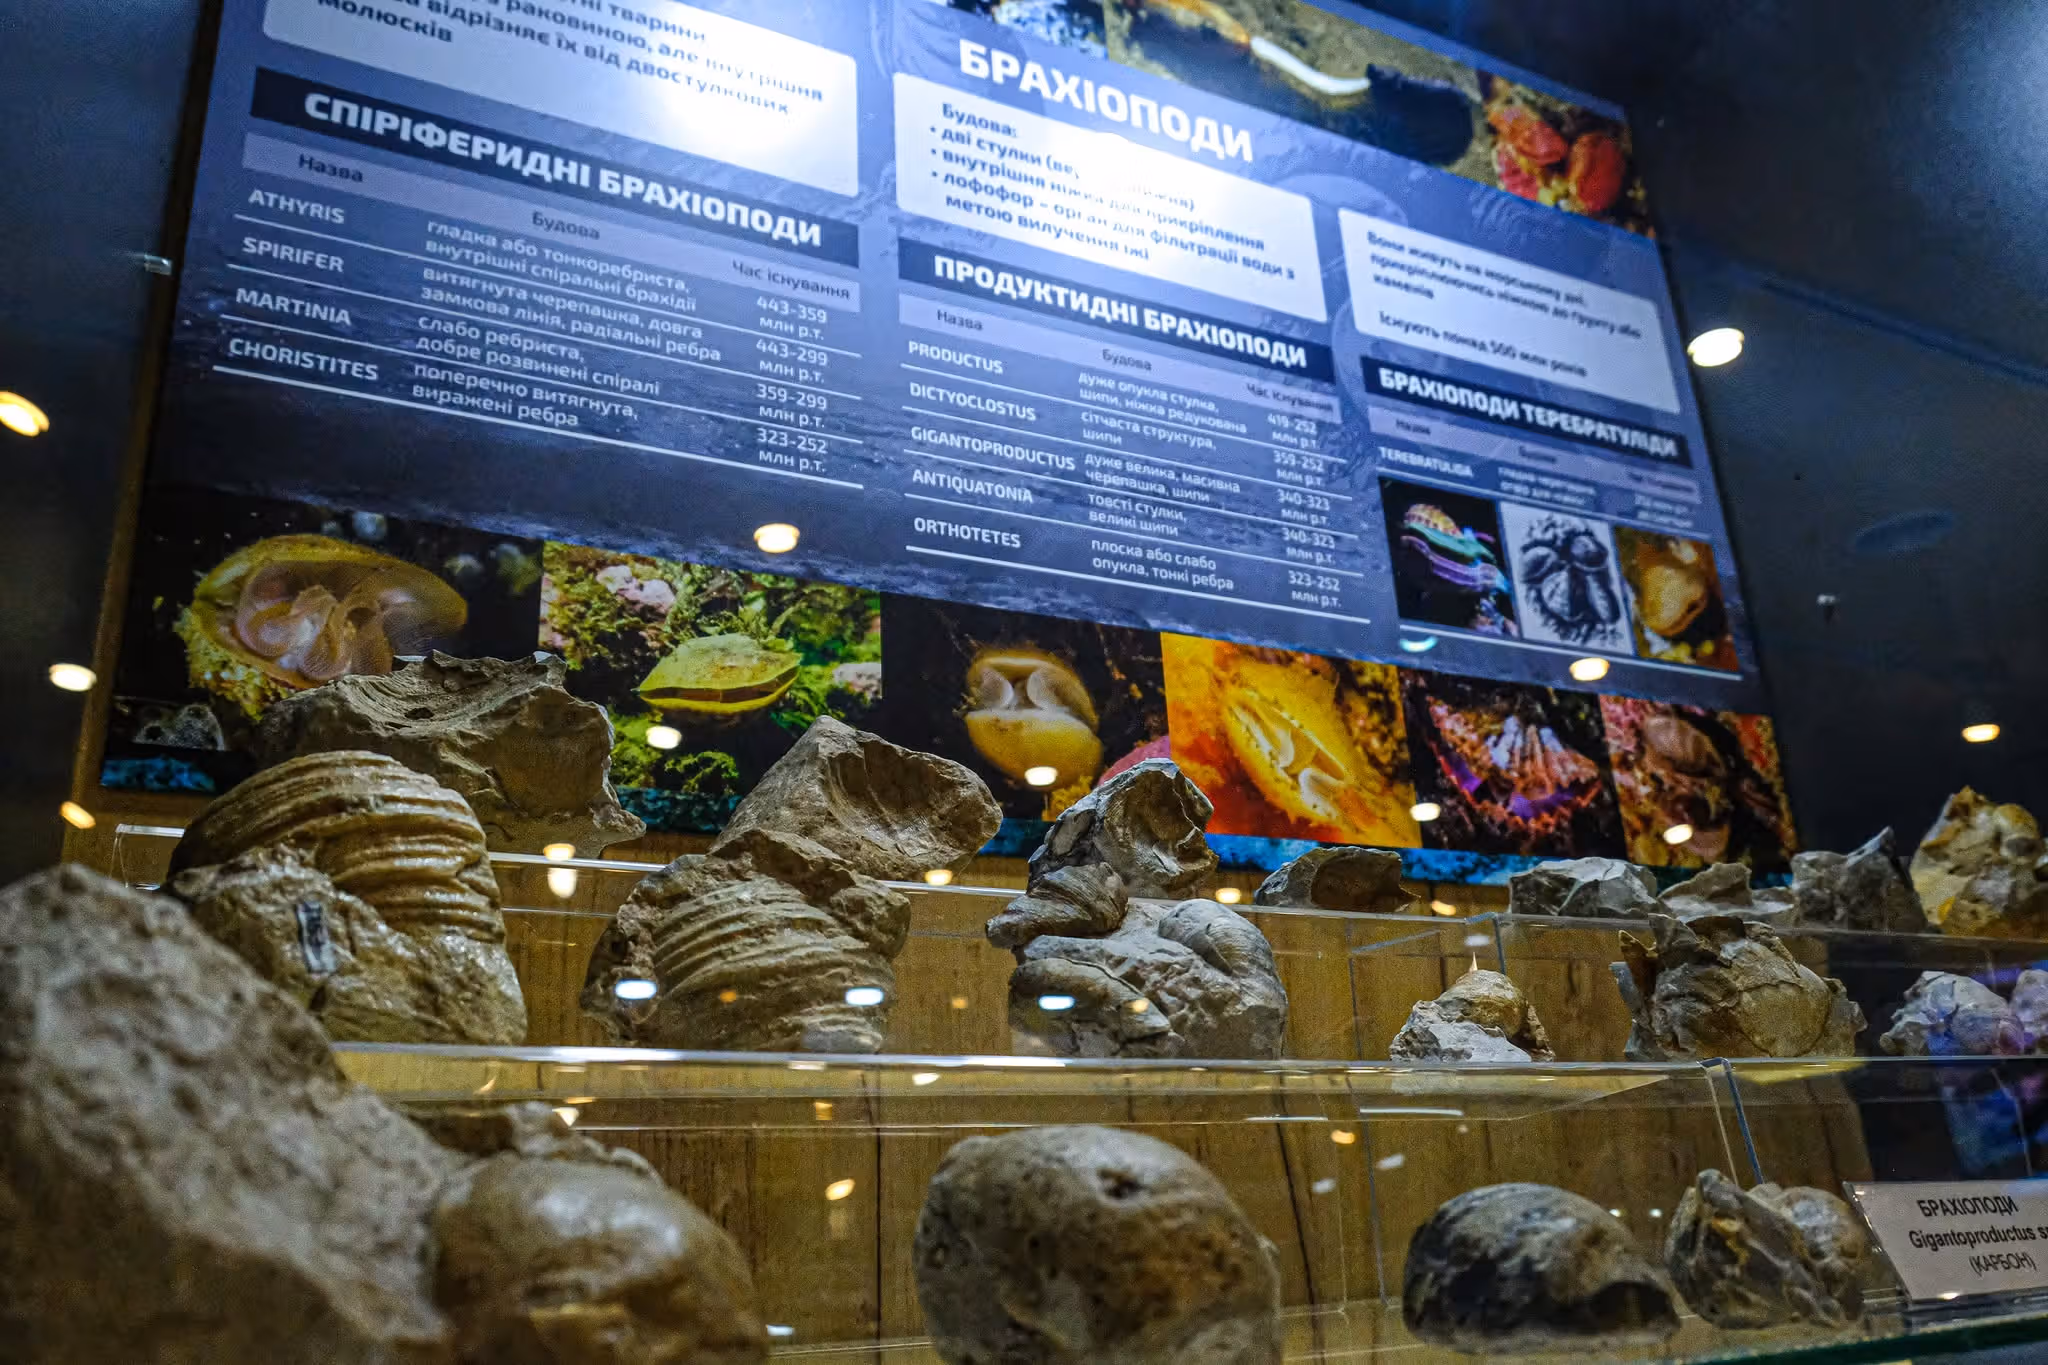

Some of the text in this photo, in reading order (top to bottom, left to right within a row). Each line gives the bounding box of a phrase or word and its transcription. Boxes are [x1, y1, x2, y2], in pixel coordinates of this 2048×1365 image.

[428, 0, 550, 46] відрізняє
[555, 31, 577, 53] їх
[584, 44, 621, 69] від
[505, 0, 653, 53] раковиною,
[658, 42, 699, 62] але
[608, 2, 705, 43] тварини
[958, 38, 1254, 164] БРАХІОПОДИ
[942, 102, 1018, 139] Будова:
[941, 127, 1041, 166] дві стулки
[298, 152, 364, 183] Назва
[304, 92, 822, 248] СПІРІФЕРИДНІ БРАХІОПОДИ
[943, 150, 1045, 189] внутрішня
[248, 189, 346, 224] ATHYRIS
[945, 194, 1014, 223] метою
[532, 210, 601, 240] Будова
[943, 173, 1034, 208] лофофор
[1150, 228, 1239, 265] фільтрації
[1242, 255, 1283, 277] води
[242, 237, 345, 273] SPIRIFER
[425, 240, 527, 273] внутрішні
[531, 263, 621, 296] спіральні
[427, 221, 690, 294] гладка або тонкоребриста,
[732, 259, 850, 300] Час існування
[236, 288, 352, 326] MARTINIA
[423, 267, 704, 340] витягнута черепашка, довга
[756, 295, 828, 324] 443-359
[934, 255, 1308, 369] ПРОДУКТИДНІ БРАХІОПОДИ
[937, 309, 984, 332] Назва
[418, 316, 586, 364] слабо ребриста,
[421, 285, 721, 362] замкова лінія, радіальні ребра
[759, 316, 825, 341] млн р.т.
[229, 338, 380, 382] CHORISTITES
[415, 336, 661, 397] добре розвинені спіралі
[756, 338, 829, 366] 443-299
[909, 340, 1004, 375] PRODUCTUS
[1102, 349, 1152, 371] Будова
[759, 360, 826, 385] млн р.т.
[412, 384, 580, 428] виражені ребра
[414, 363, 639, 422] поперечно витягнута,
[756, 383, 829, 411] 359-299
[909, 382, 1037, 422] DICTYOCLOSTUS
[1118, 381, 1169, 402] опукла
[1378, 367, 1521, 421] БРАХІОПОДИ
[759, 406, 826, 430] млн р.т.
[1080, 411, 1141, 433] сітчаста
[1168, 407, 1248, 434] редукована
[756, 428, 829, 455] 323-252
[911, 426, 1076, 471] GIGANTOPRODUCTUS
[1083, 428, 1123, 445] шипи
[759, 450, 827, 474] млн р.т.
[1126, 460, 1180, 482] велика,
[1182, 472, 1241, 493] масивна
[912, 469, 1034, 504] ANTIQUATONIA
[1086, 469, 1210, 503] черепашка, шипи
[1088, 493, 1188, 523] товсті стулки,
[1089, 511, 1179, 537] великі шипи
[914, 517, 1022, 549] ORTHOTETES
[1091, 540, 1217, 571] плоска або слабо
[1093, 557, 1235, 591] опукла, тонкі ребра
[1288, 570, 1341, 593] 323-252
[1291, 590, 1320, 605] млн
[1918, 1195, 2020, 1218] БРАХІОПОДИ
[1908, 1226, 2048, 1252] Gigantoproductus s
[1968, 1252, 2038, 1278] (КАРБОН)
